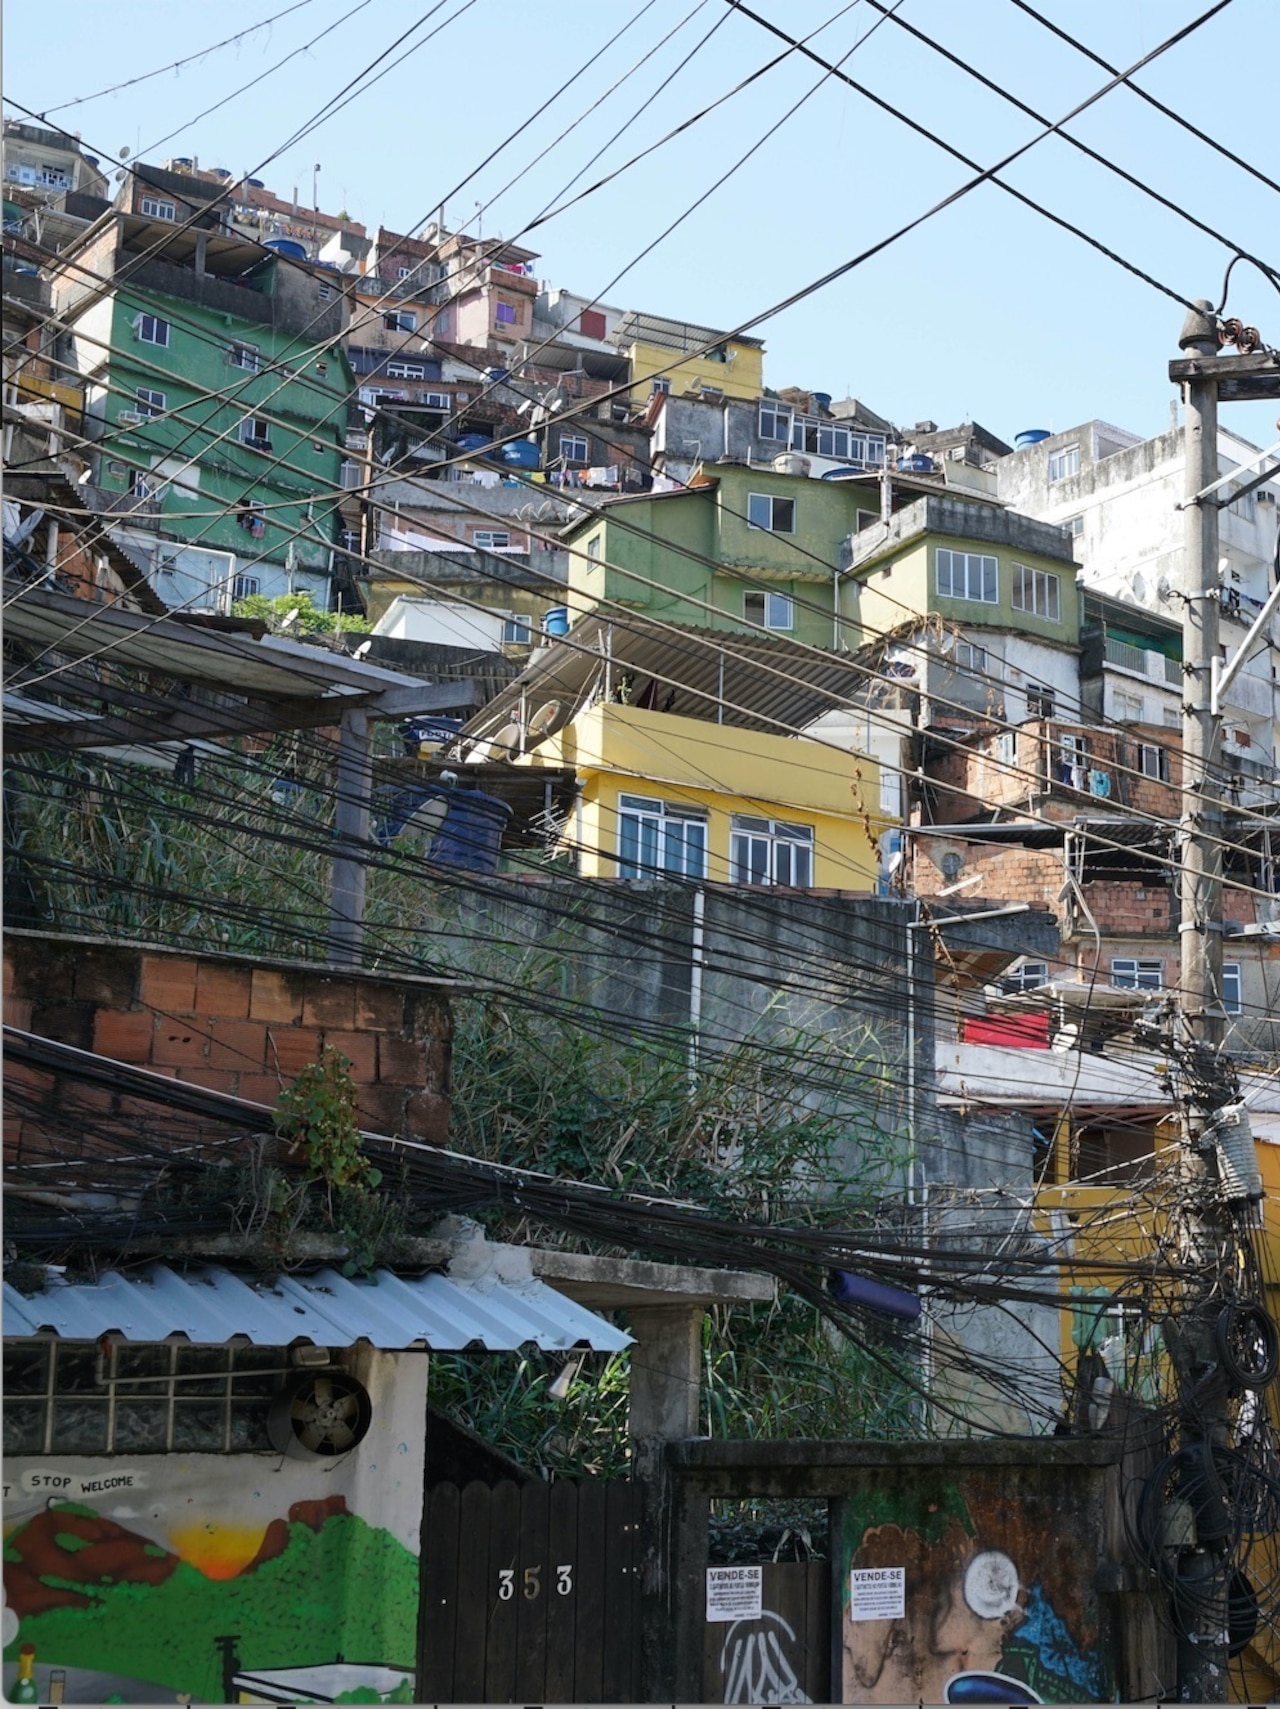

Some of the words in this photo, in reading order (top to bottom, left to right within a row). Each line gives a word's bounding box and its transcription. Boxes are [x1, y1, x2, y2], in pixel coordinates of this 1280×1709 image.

[31, 1475, 72, 1488] STOP
[81, 1476, 134, 1493] WELCOME
[709, 1569, 760, 1581] VENDE-SE
[853, 1570, 902, 1582] VENDE-SE
